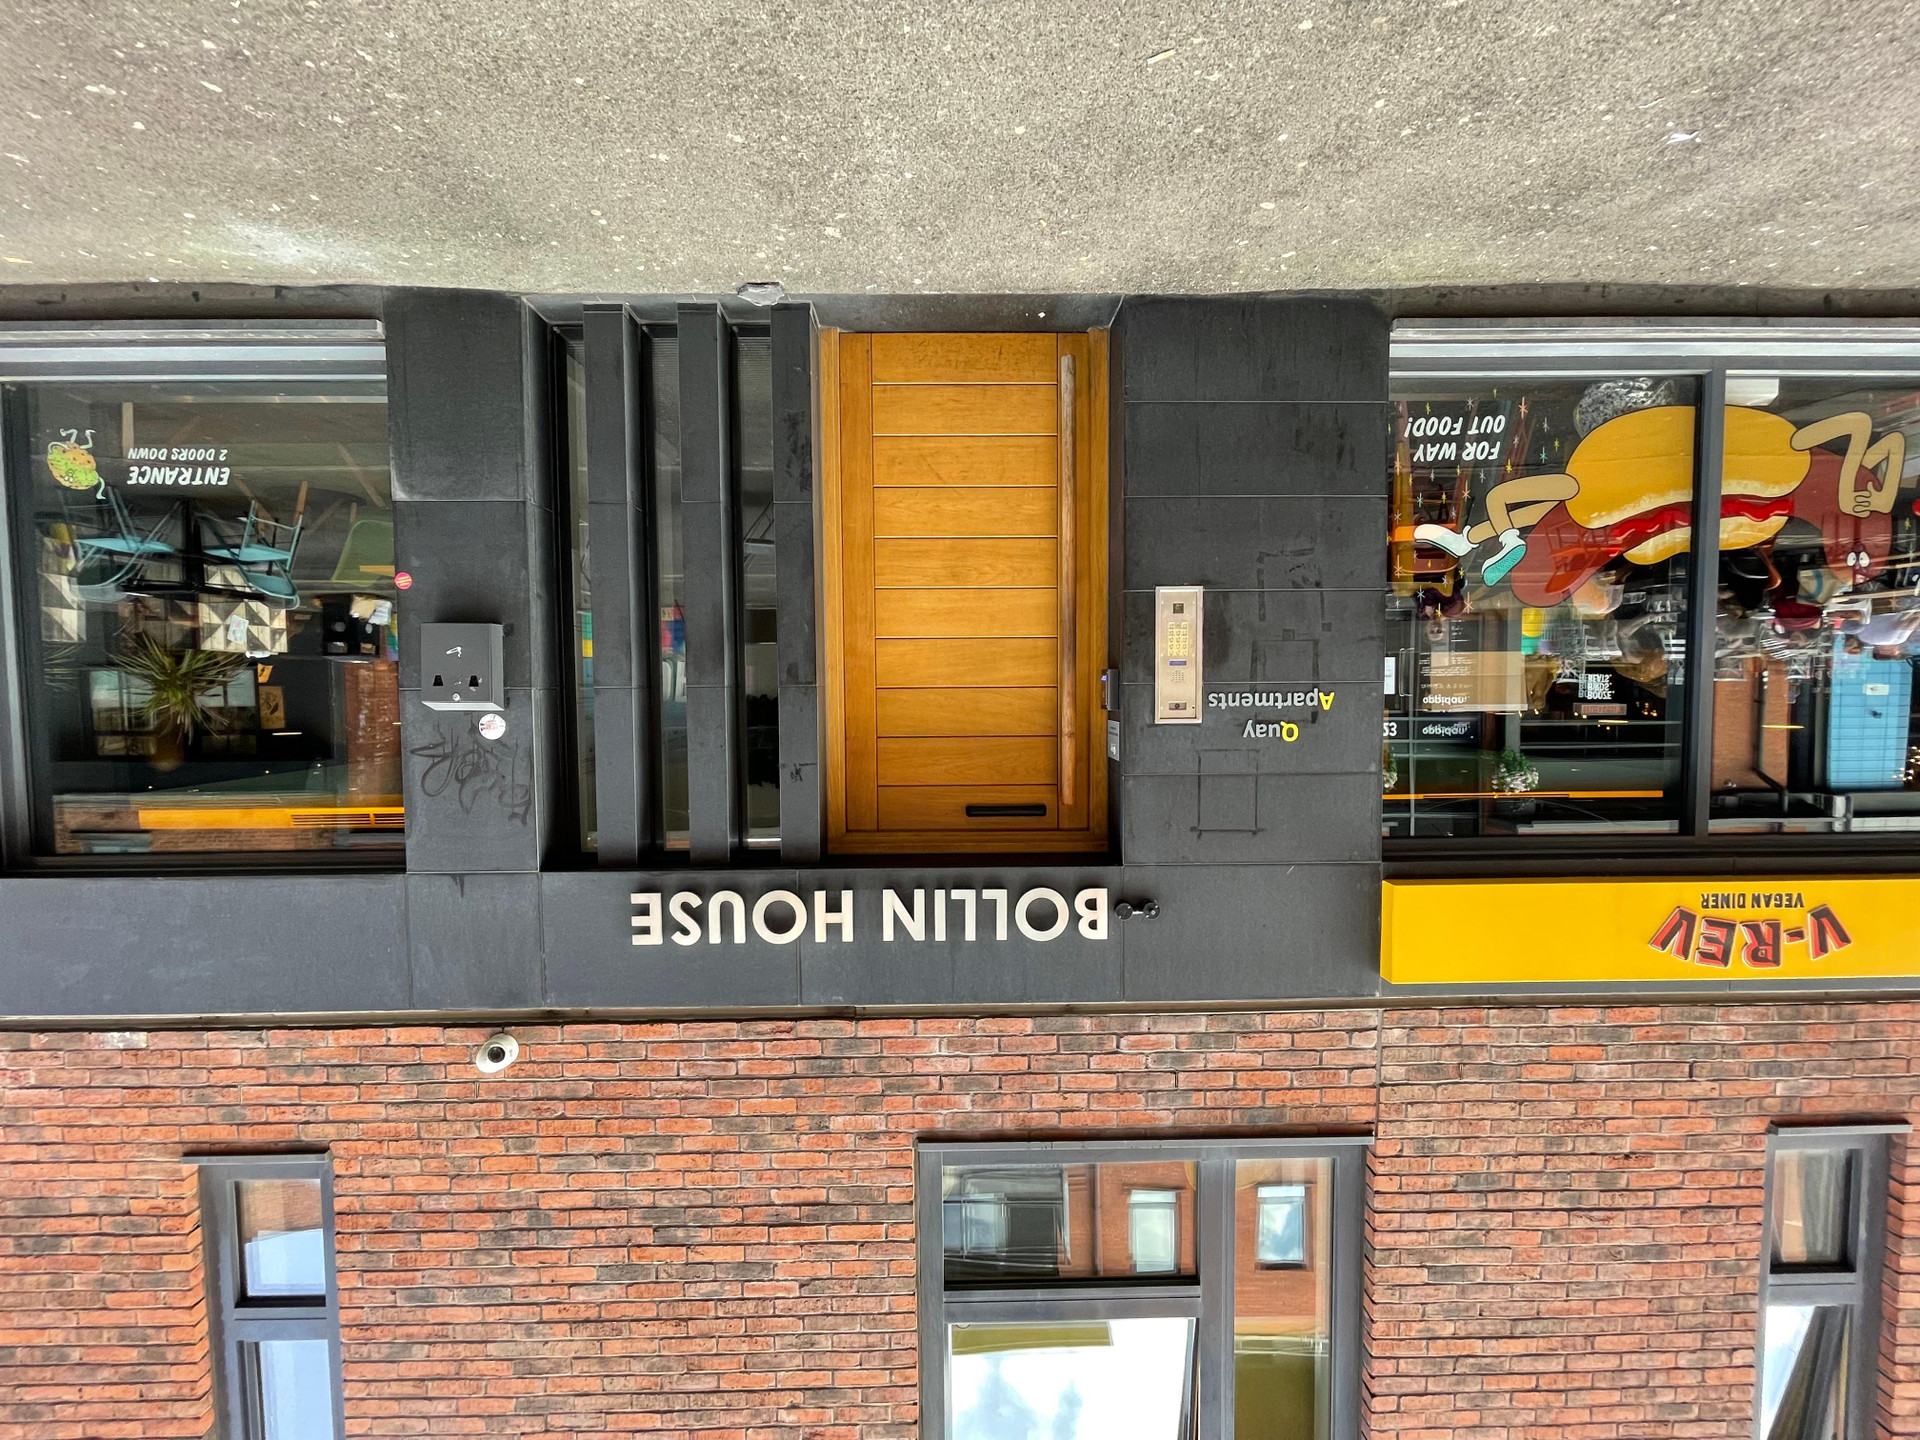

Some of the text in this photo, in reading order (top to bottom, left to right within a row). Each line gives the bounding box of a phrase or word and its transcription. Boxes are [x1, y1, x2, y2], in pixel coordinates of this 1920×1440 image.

[1403, 414, 1506, 438] OUT FOOD!
[127, 447, 228, 461] 2 DOORS DOWN
[1413, 441, 1501, 462] FOR WAY
[126, 465, 231, 486] ENTRANCE
[1208, 688, 1335, 711] Apartments
[1243, 719, 1299, 742] Quay
[1701, 893, 1804, 909] VEGAN DINER
[630, 886, 1109, 946] BOLLIN HOUSE
[1648, 904, 1852, 969] V-REV
